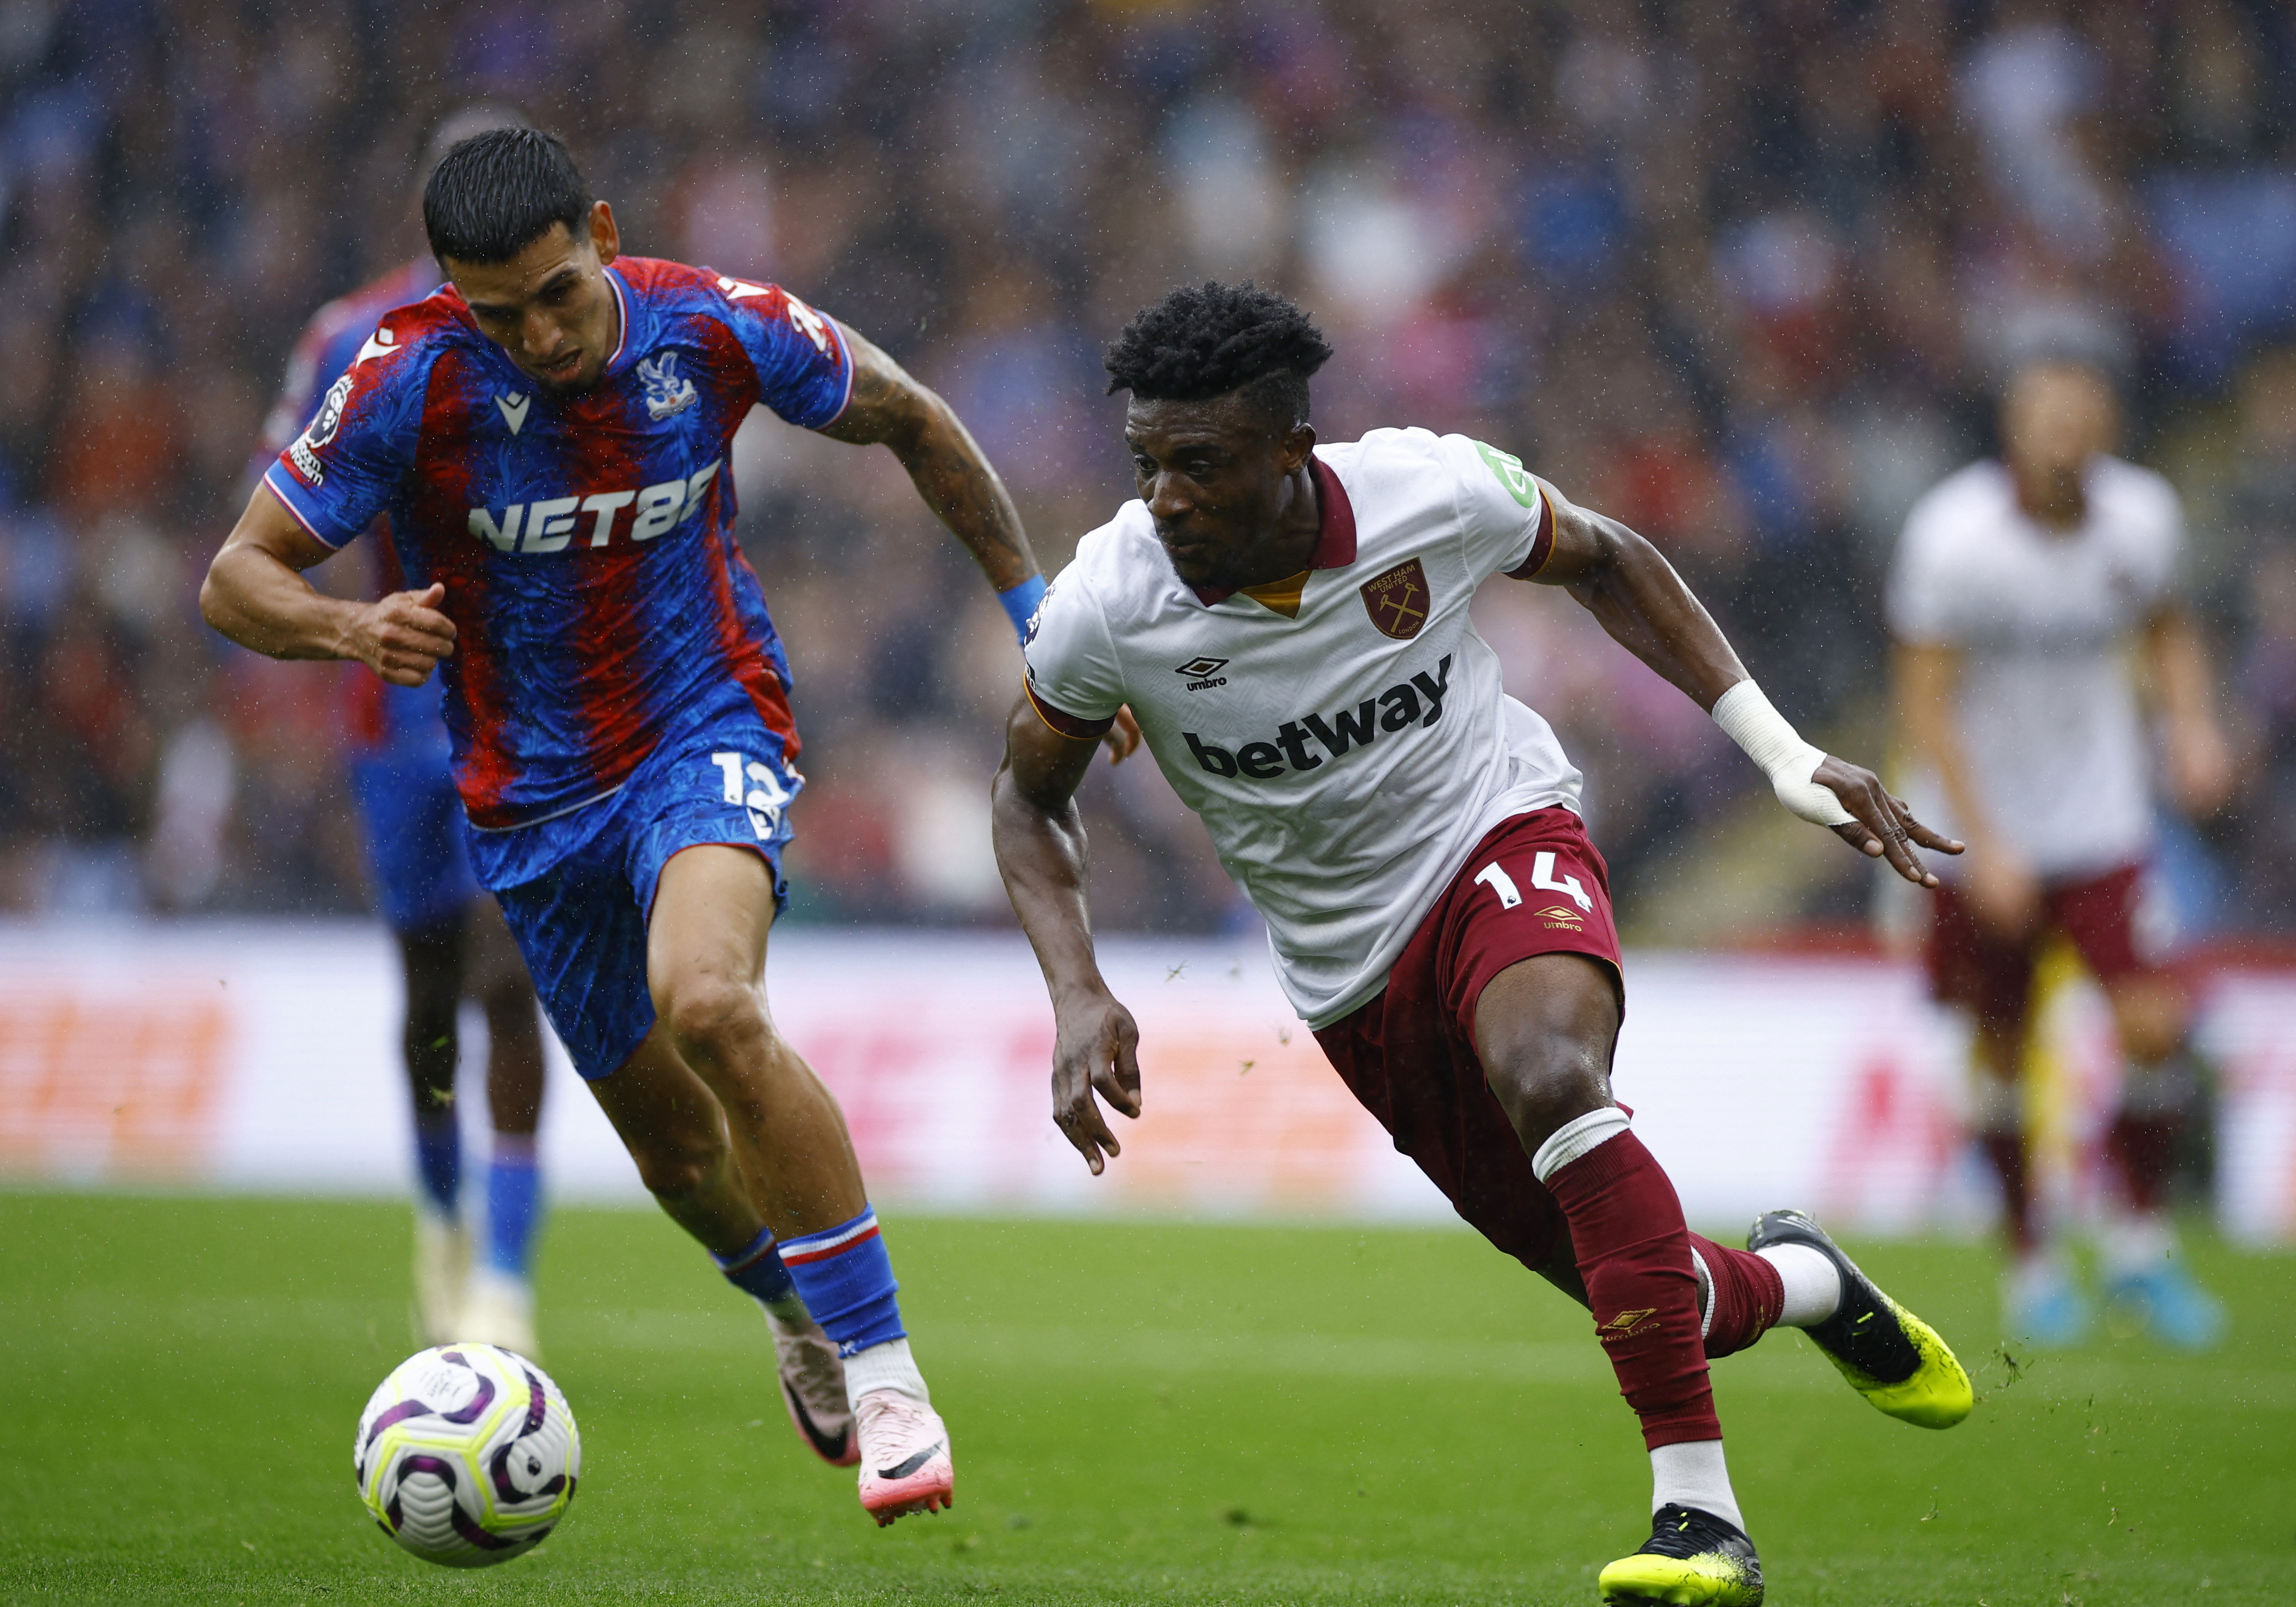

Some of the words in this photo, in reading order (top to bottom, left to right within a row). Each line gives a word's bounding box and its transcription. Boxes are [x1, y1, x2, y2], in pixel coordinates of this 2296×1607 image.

[1368, 574, 1392, 593] WEST
[1393, 564, 1416, 580] HAM
[1380, 576, 1408, 593] UNITED
[1399, 620, 1419, 634] LONDON
[1186, 676, 1227, 691] umbro
[1182, 653, 1451, 779] betway
[1474, 852, 1593, 914] 14
[1543, 921, 1583, 932] umbro
